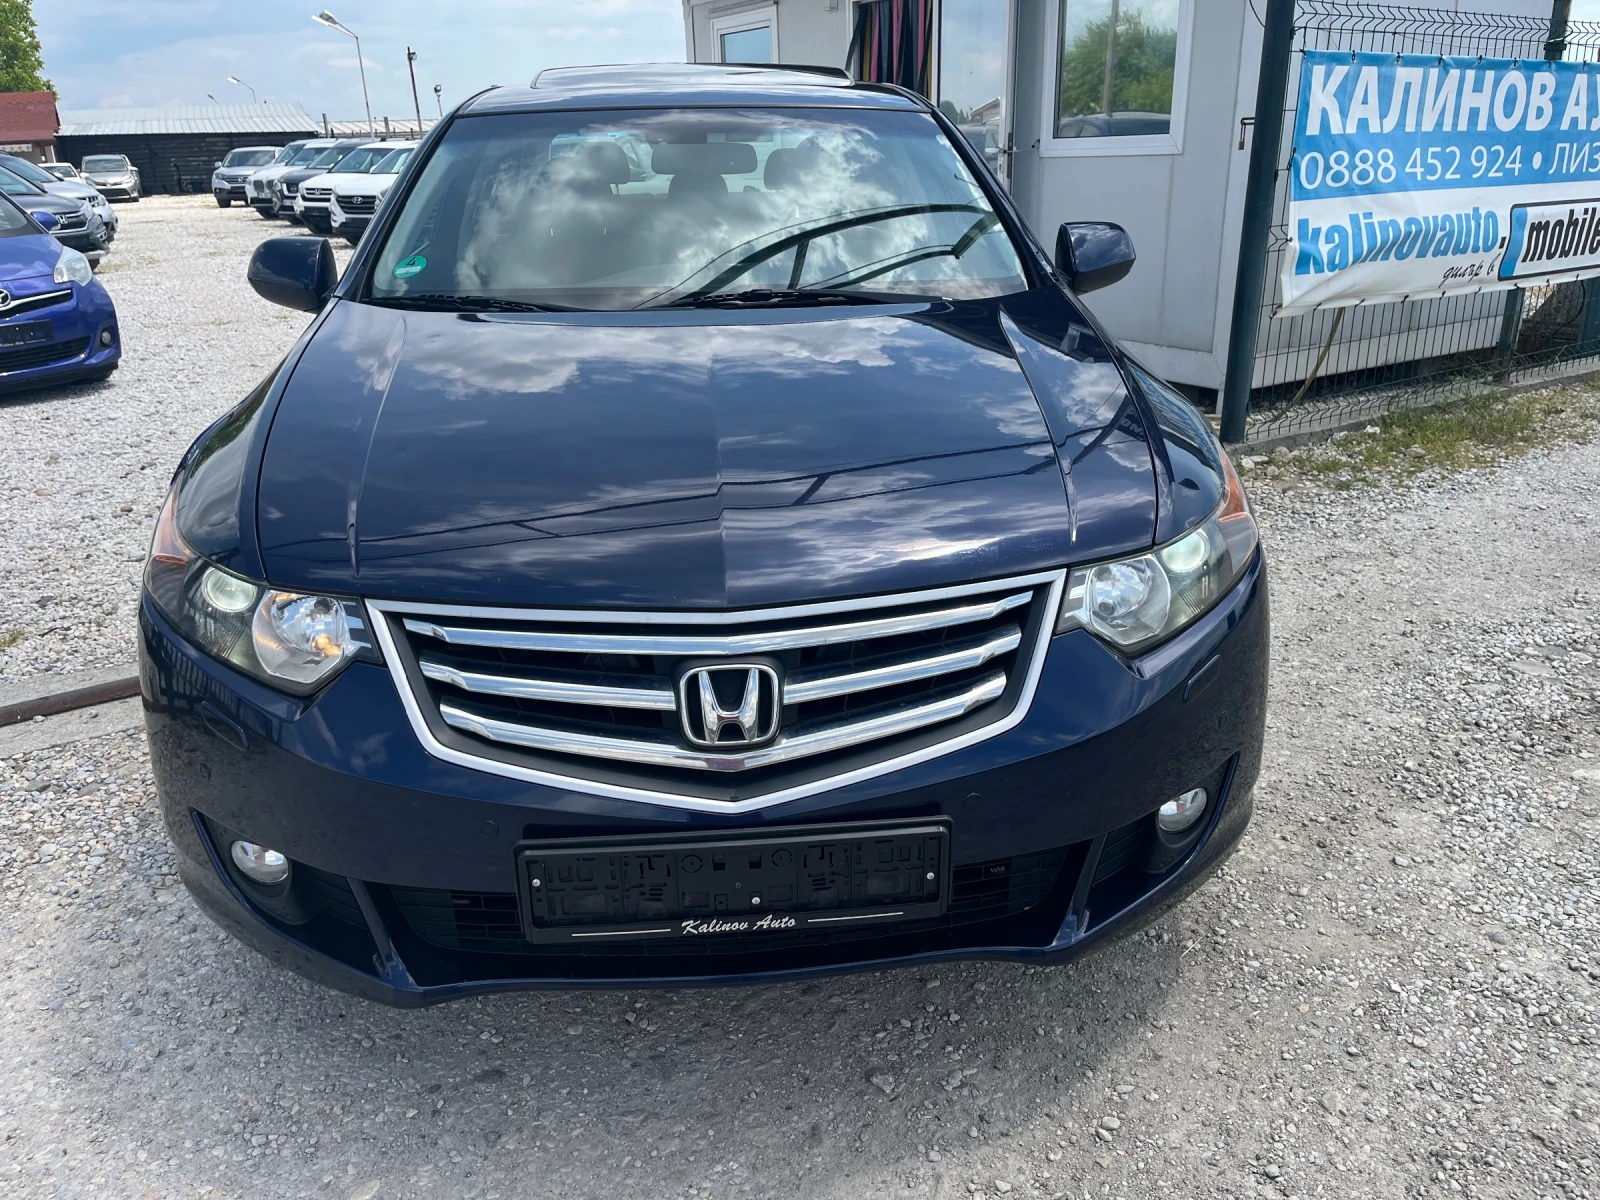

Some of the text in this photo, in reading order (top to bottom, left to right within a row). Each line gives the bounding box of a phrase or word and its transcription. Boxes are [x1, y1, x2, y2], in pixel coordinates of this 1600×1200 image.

[1305, 64, 1556, 136] КАЛИНОВ
[1300, 147, 1397, 189] 0888
[1404, 145, 1461, 181] 452
[1470, 144, 1523, 178] 924
[405, 256, 416, 267] 4
[681, 914, 797, 935] Kalinov Auto
